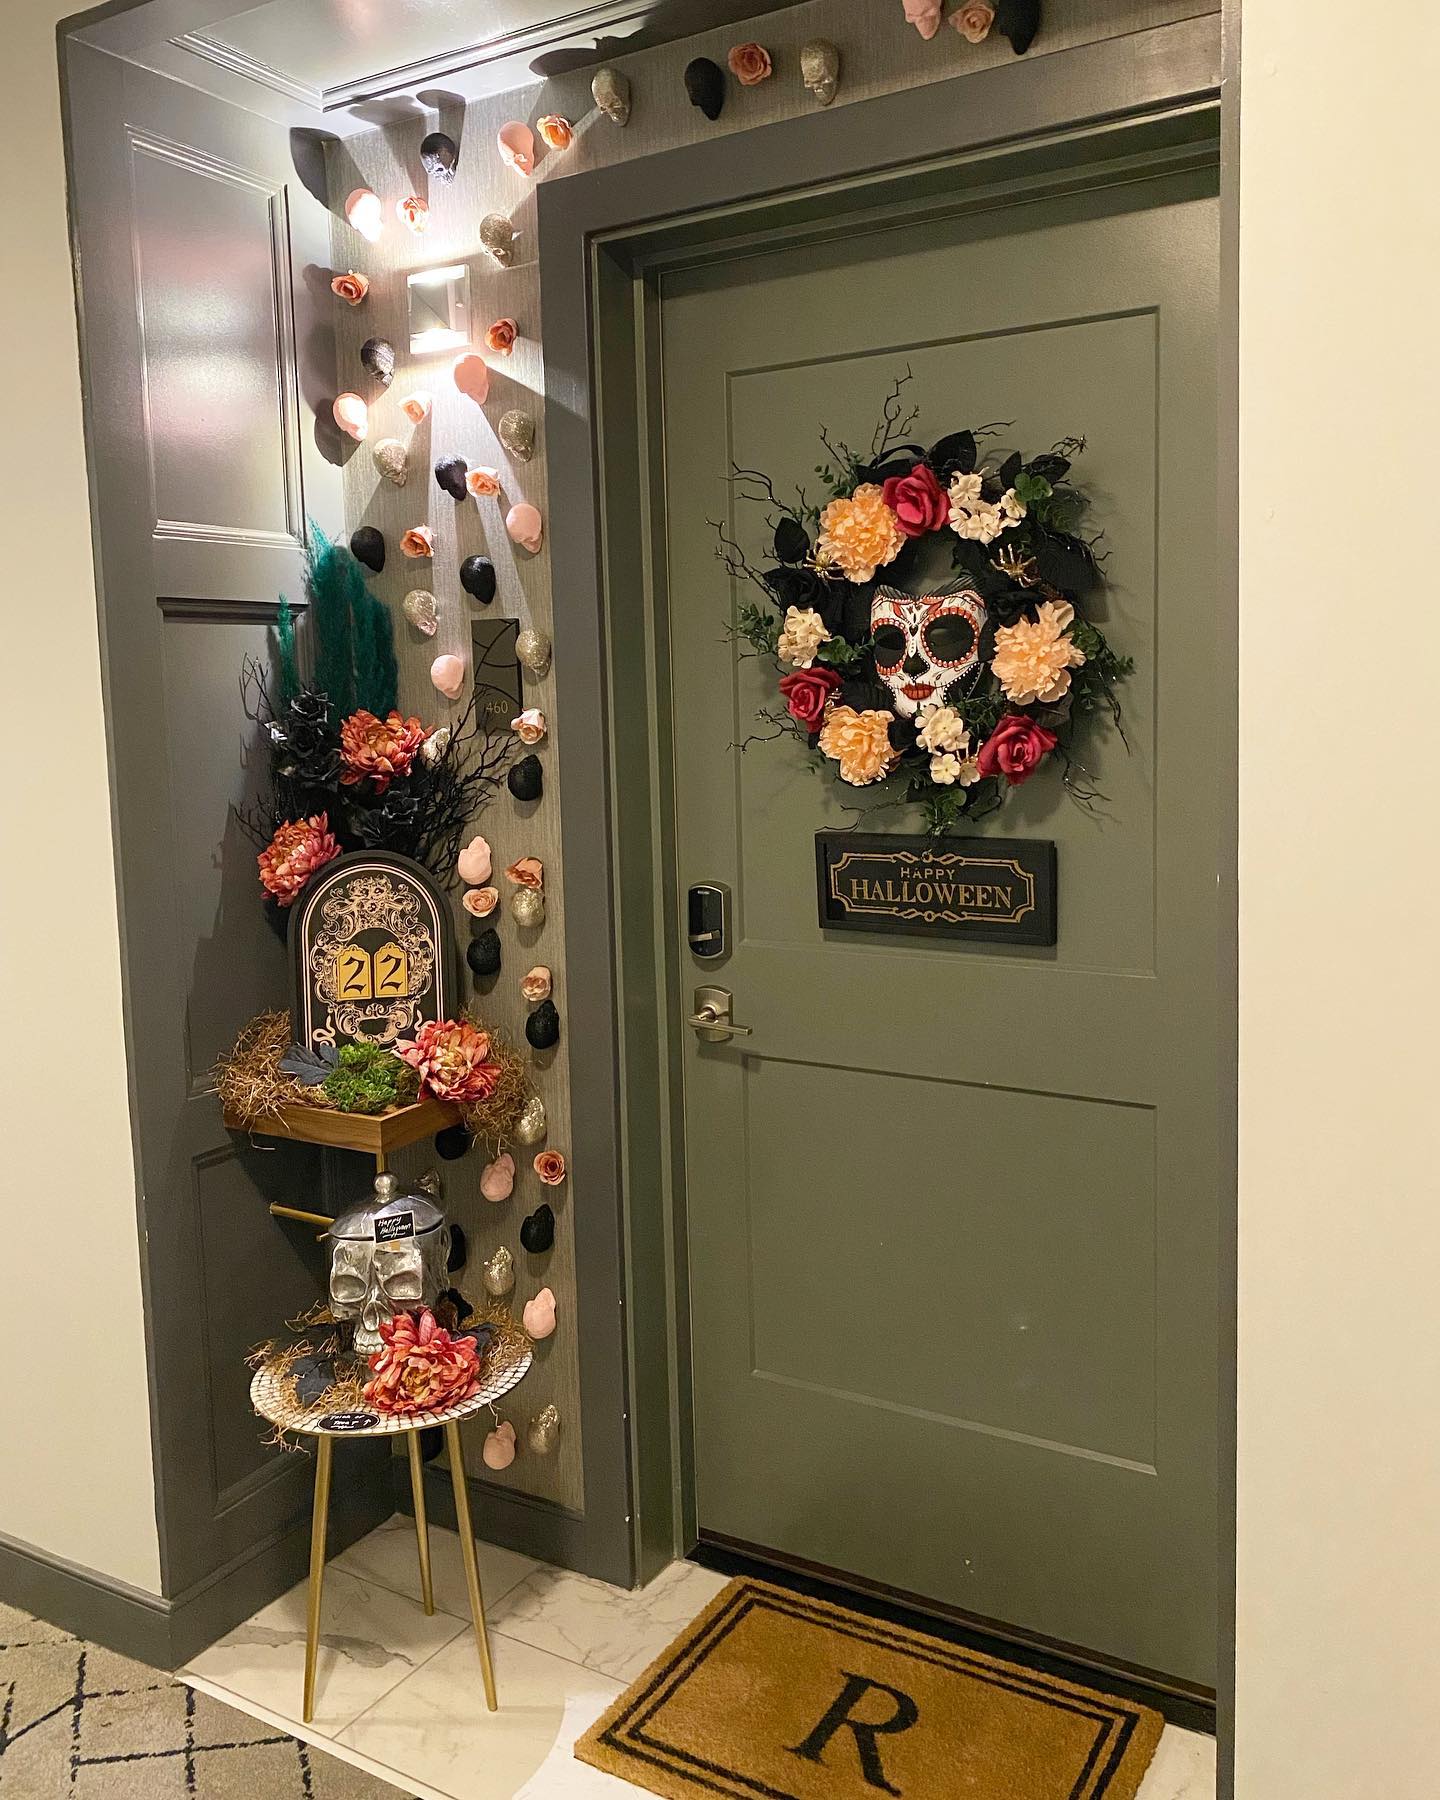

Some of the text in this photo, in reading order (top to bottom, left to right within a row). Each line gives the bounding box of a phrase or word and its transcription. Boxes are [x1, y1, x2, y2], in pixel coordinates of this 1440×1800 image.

[486, 700, 508, 714] 460
[900, 867, 956, 880] HAPPY
[850, 879, 1012, 909] HALLOWEEN
[782, 1669, 920, 1798] R
